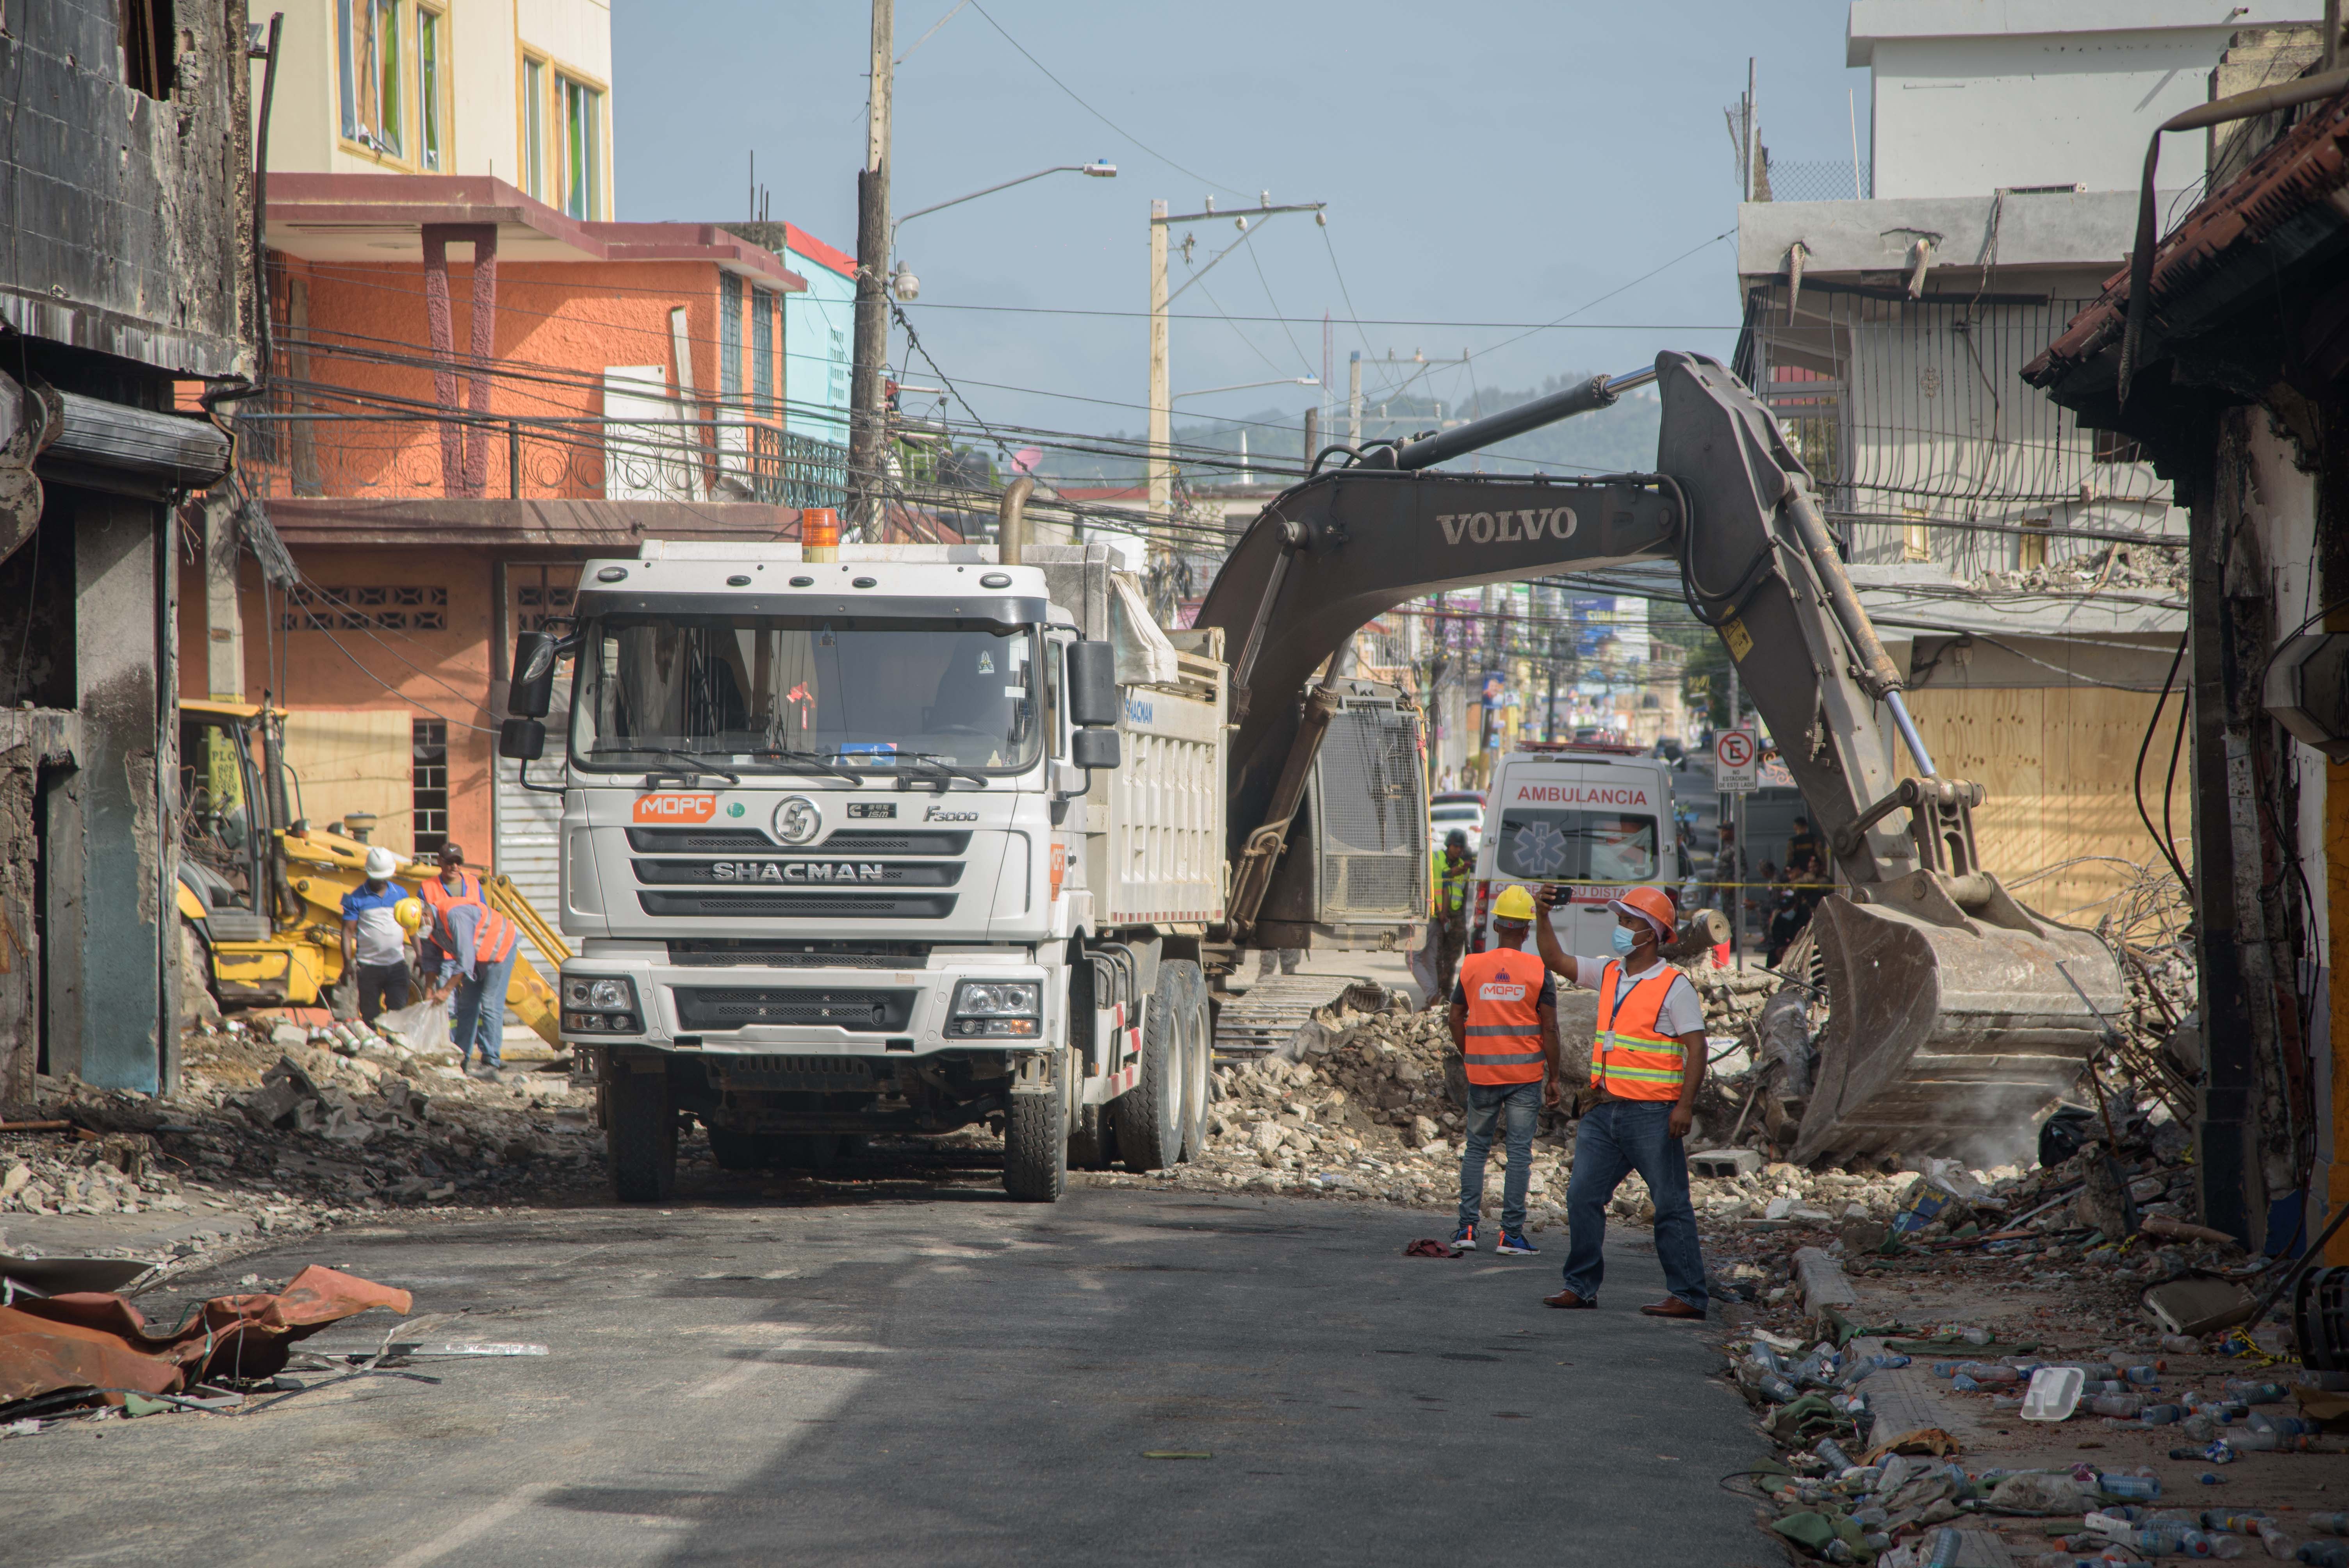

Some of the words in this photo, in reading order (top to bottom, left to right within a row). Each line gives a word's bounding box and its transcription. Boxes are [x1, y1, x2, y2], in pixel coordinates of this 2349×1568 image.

[1436, 506, 1577, 545] VOLVO
[1517, 786, 1647, 805] AMBULANCIA
[641, 798, 712, 814] MOPC
[923, 805, 979, 821] F3000
[712, 862, 883, 882] SHACMAN
[1591, 886, 1631, 898] DISTA
[1484, 985, 1523, 996] MOPC
